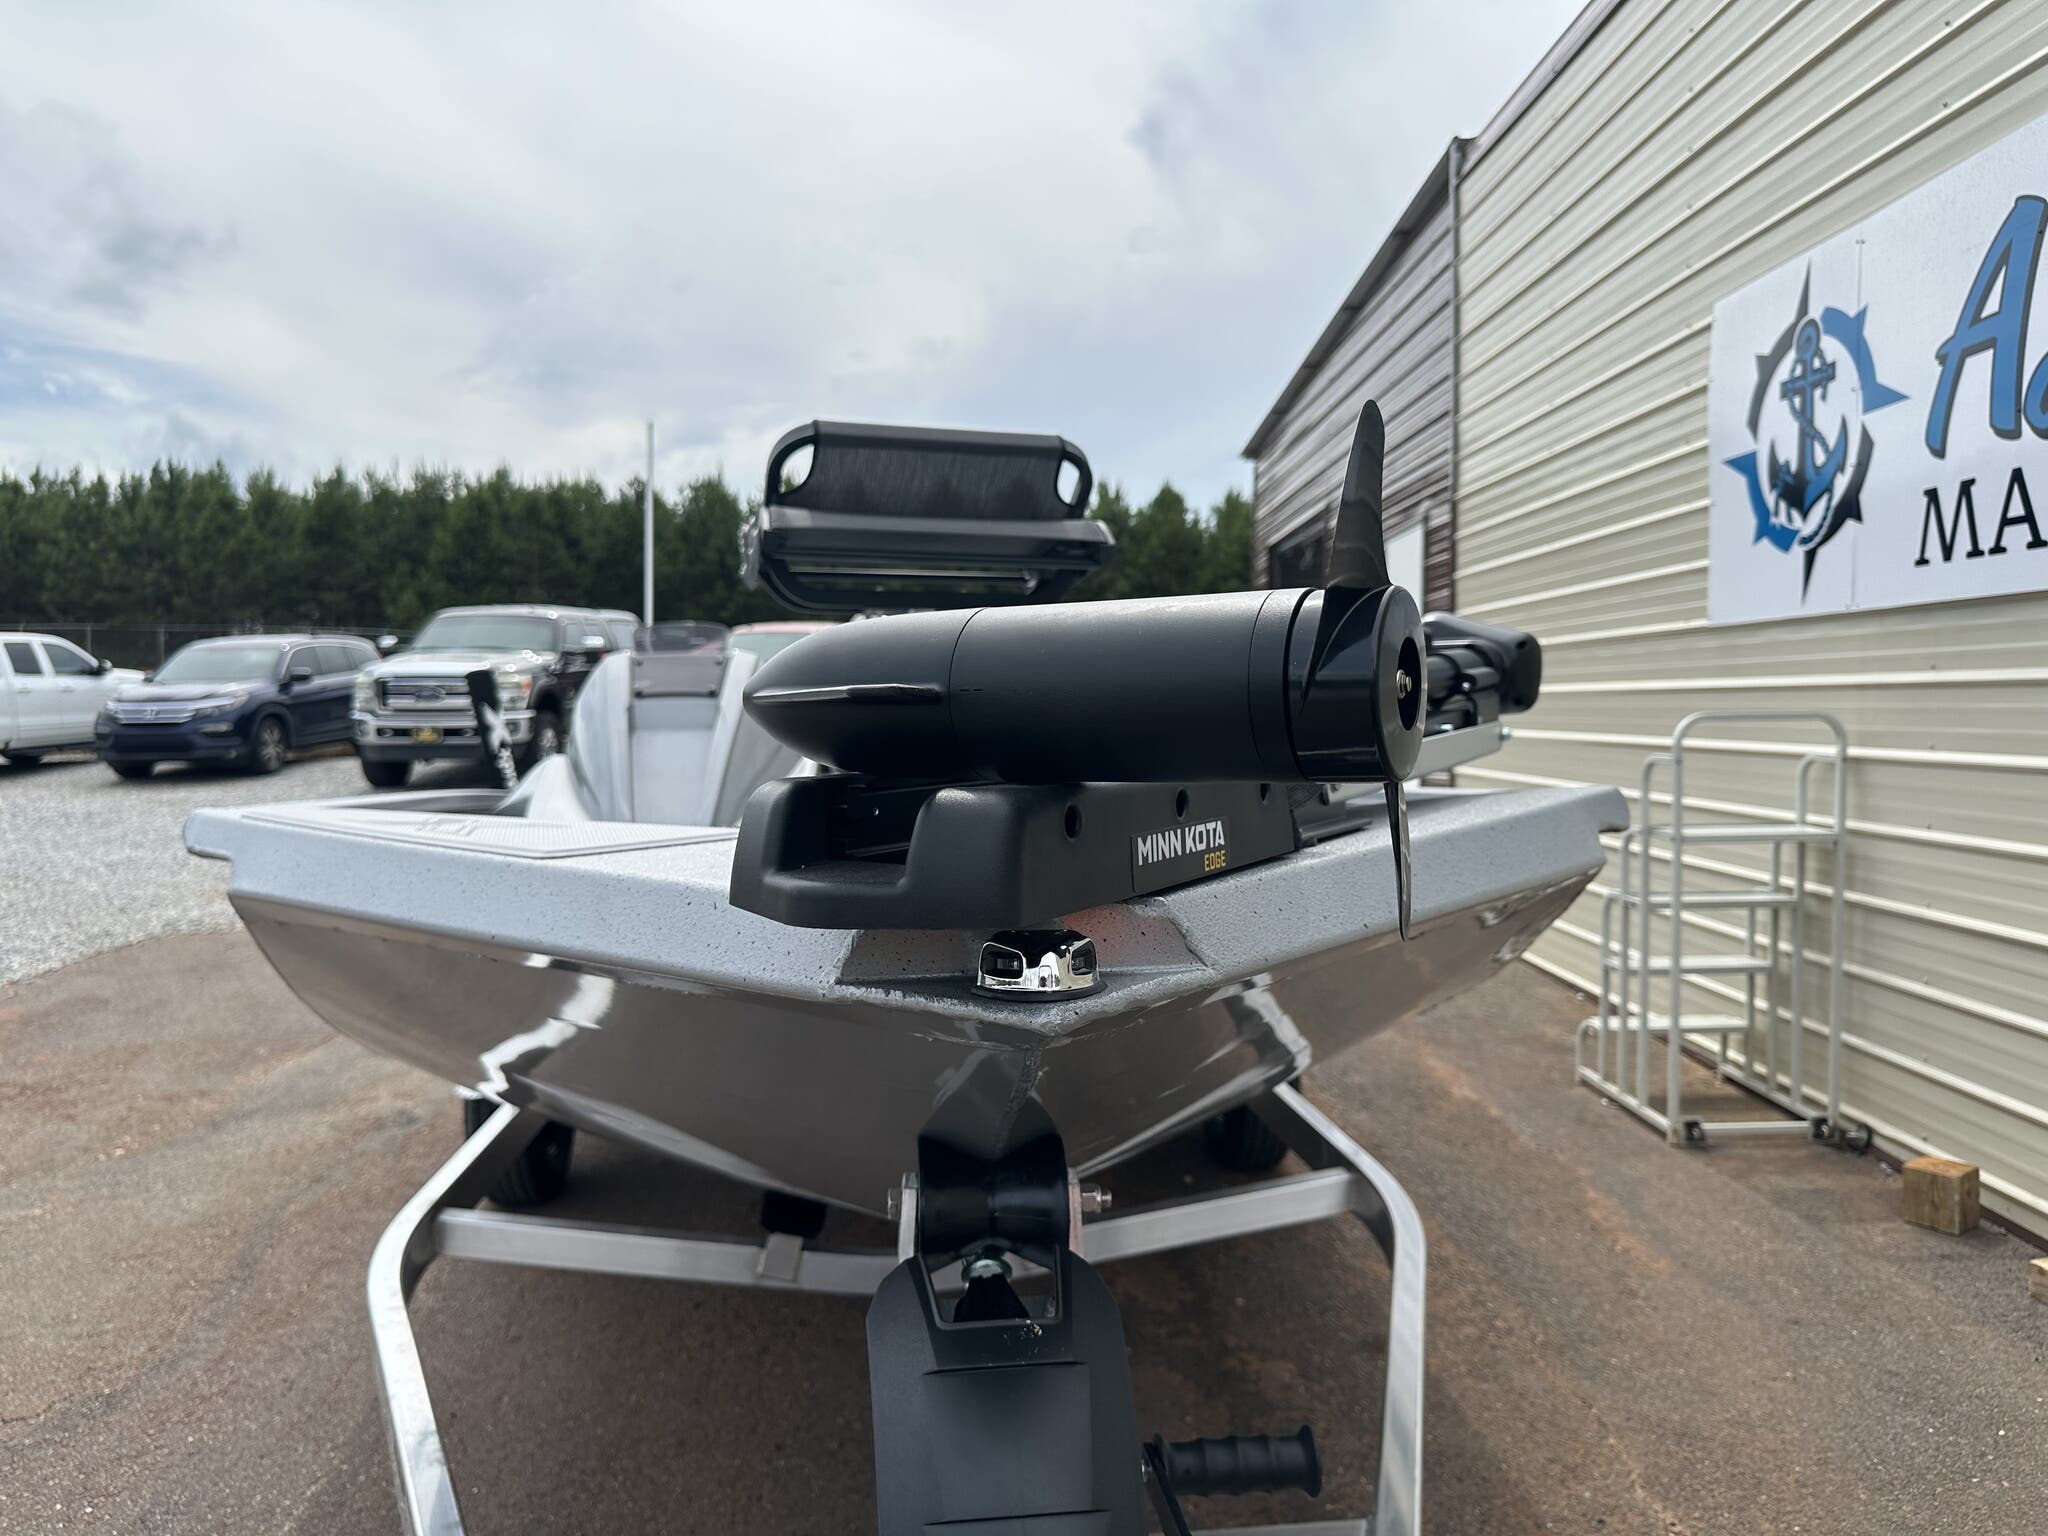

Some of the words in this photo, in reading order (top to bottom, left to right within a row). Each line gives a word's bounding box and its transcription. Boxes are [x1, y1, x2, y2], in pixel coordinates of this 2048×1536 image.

[1137, 828, 1182, 866] MINN
[1185, 820, 1225, 854] KOTA
[1204, 850, 1226, 871] EDGE
